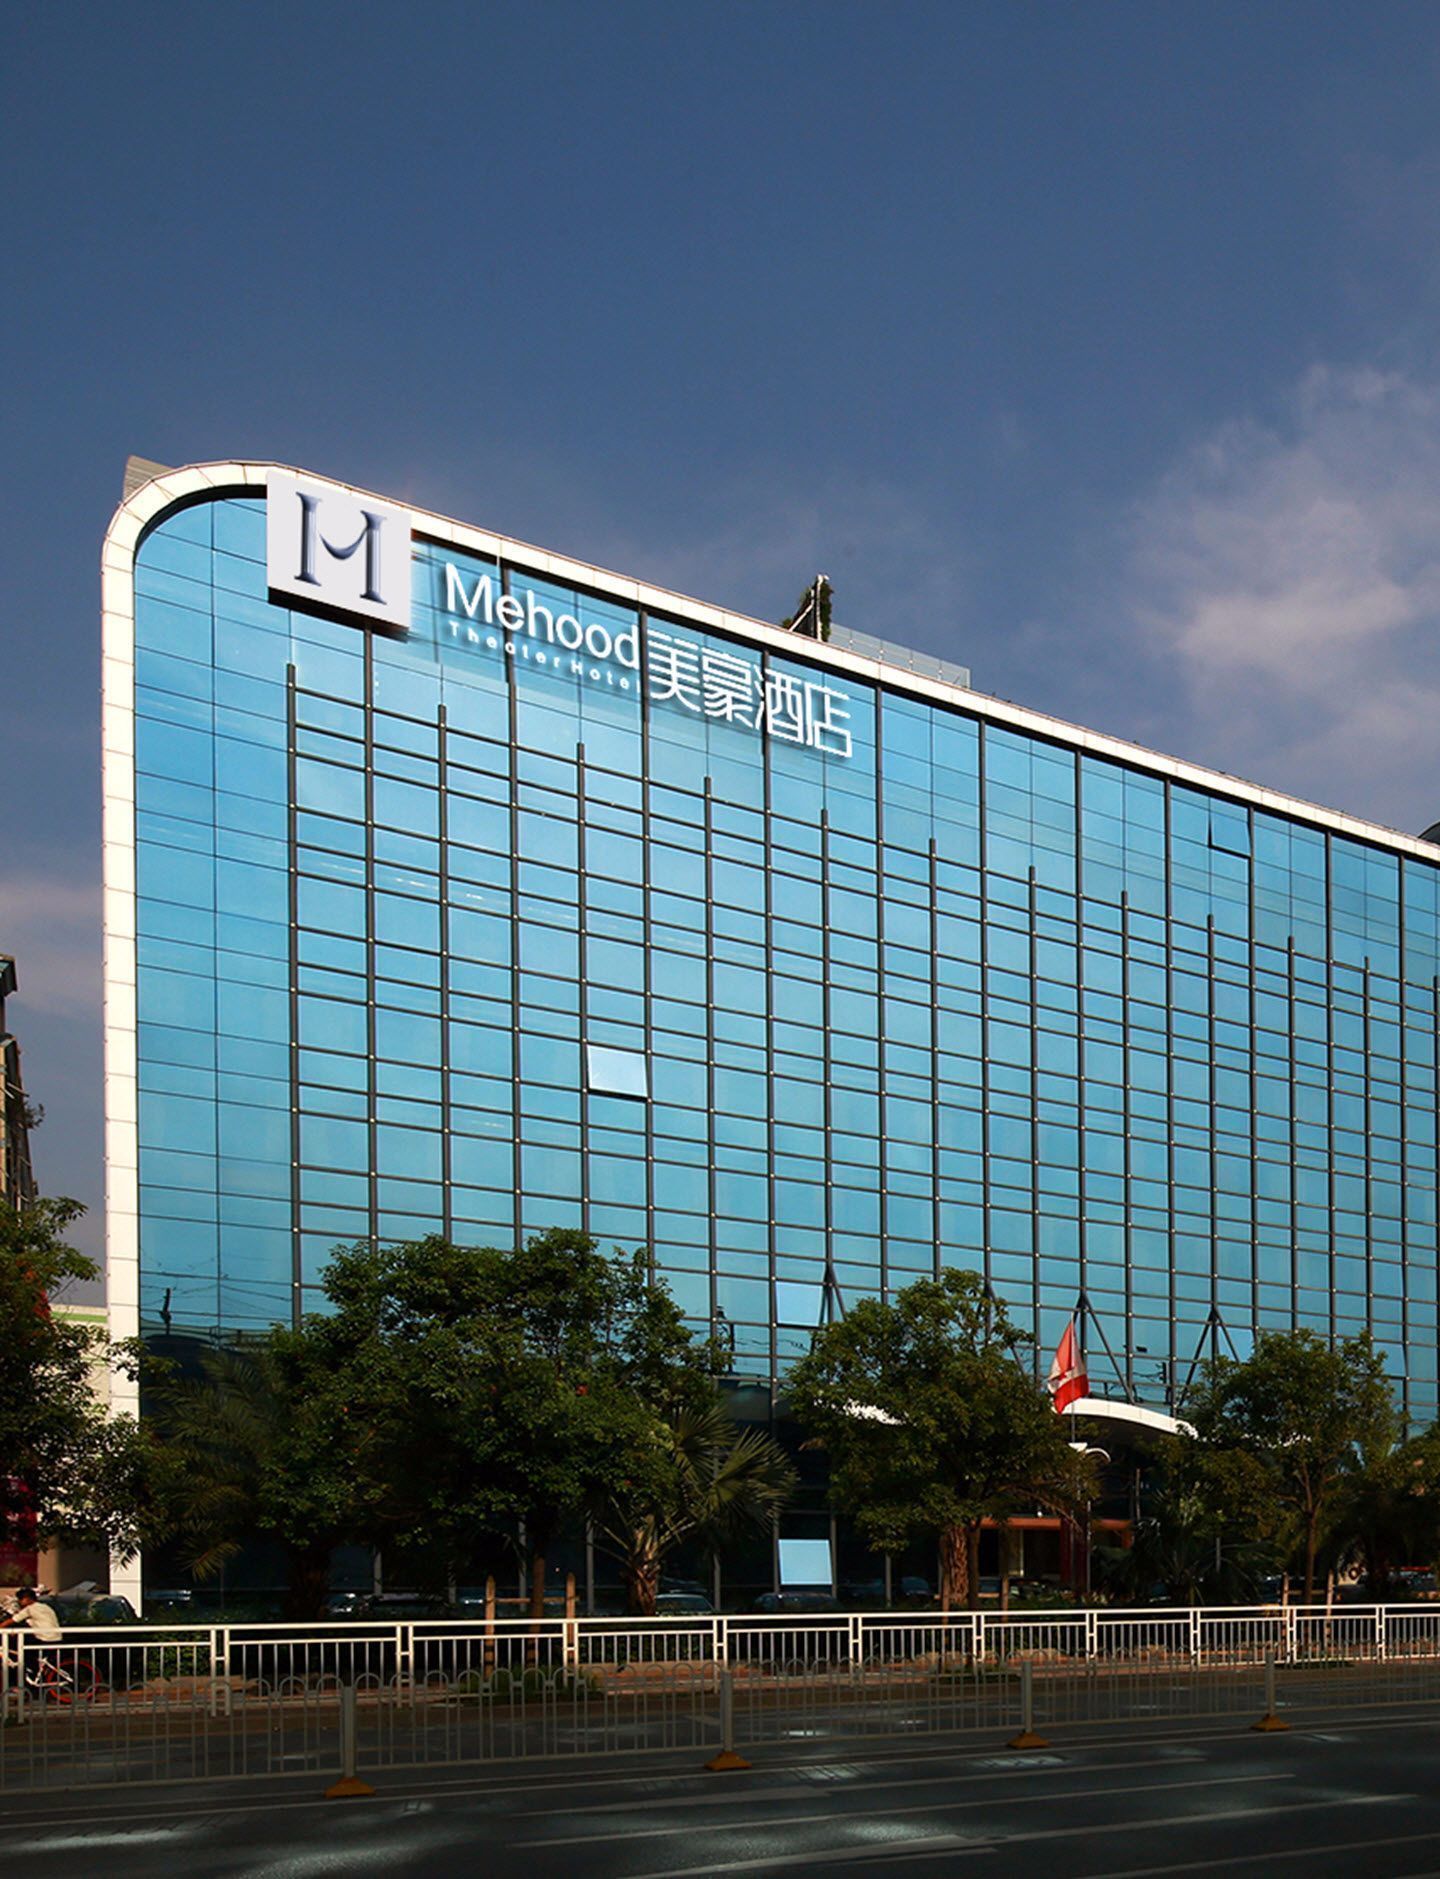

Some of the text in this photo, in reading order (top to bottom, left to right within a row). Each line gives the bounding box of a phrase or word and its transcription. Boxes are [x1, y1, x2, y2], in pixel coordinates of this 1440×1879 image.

[445, 562, 640, 671] Mehood
[448, 620, 641, 694] Theater Hotel
[646, 627, 854, 760] 美豪酒店
